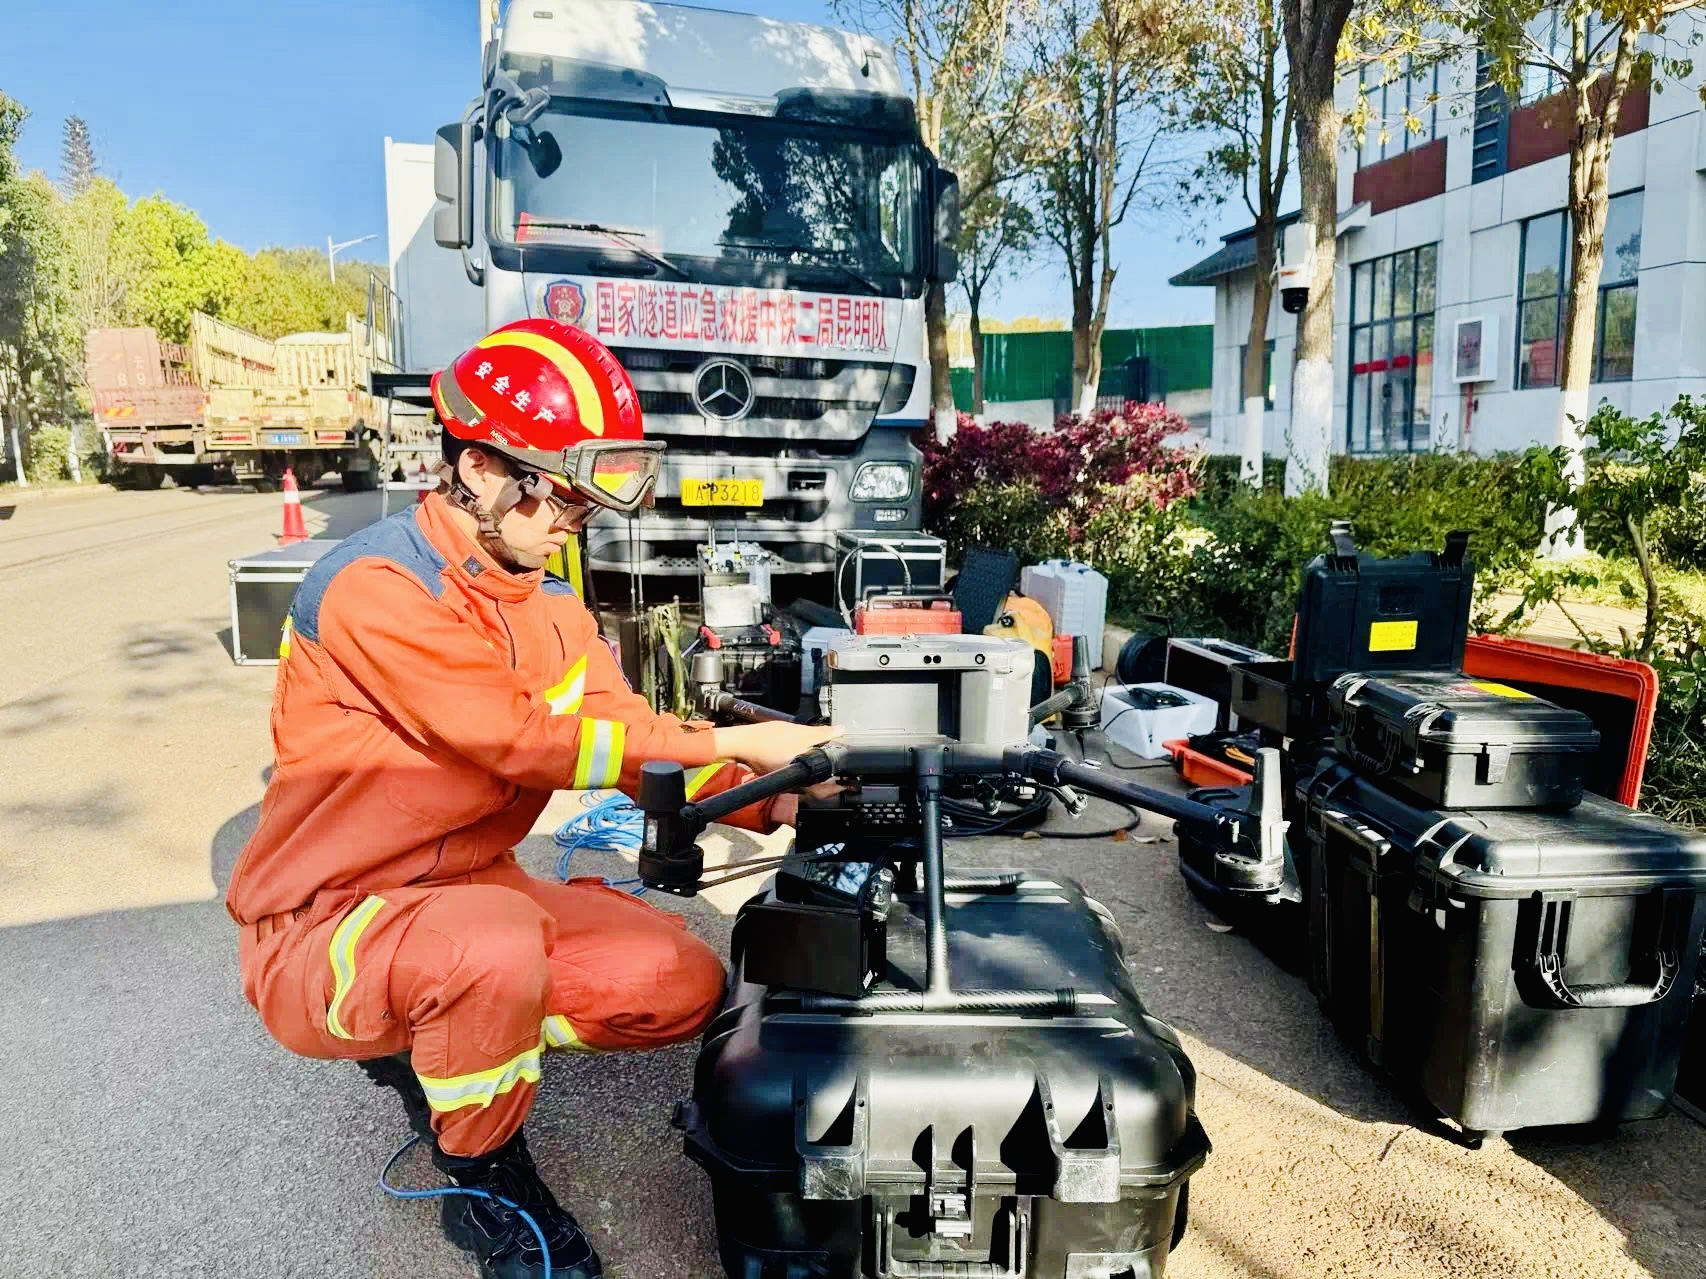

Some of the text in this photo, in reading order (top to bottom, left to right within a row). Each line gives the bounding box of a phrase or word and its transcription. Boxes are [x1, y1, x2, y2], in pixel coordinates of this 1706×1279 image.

[595, 281, 887, 348] 国家隧道应急救援中铁二局昆明队
[474, 361, 556, 424] 安全生产
